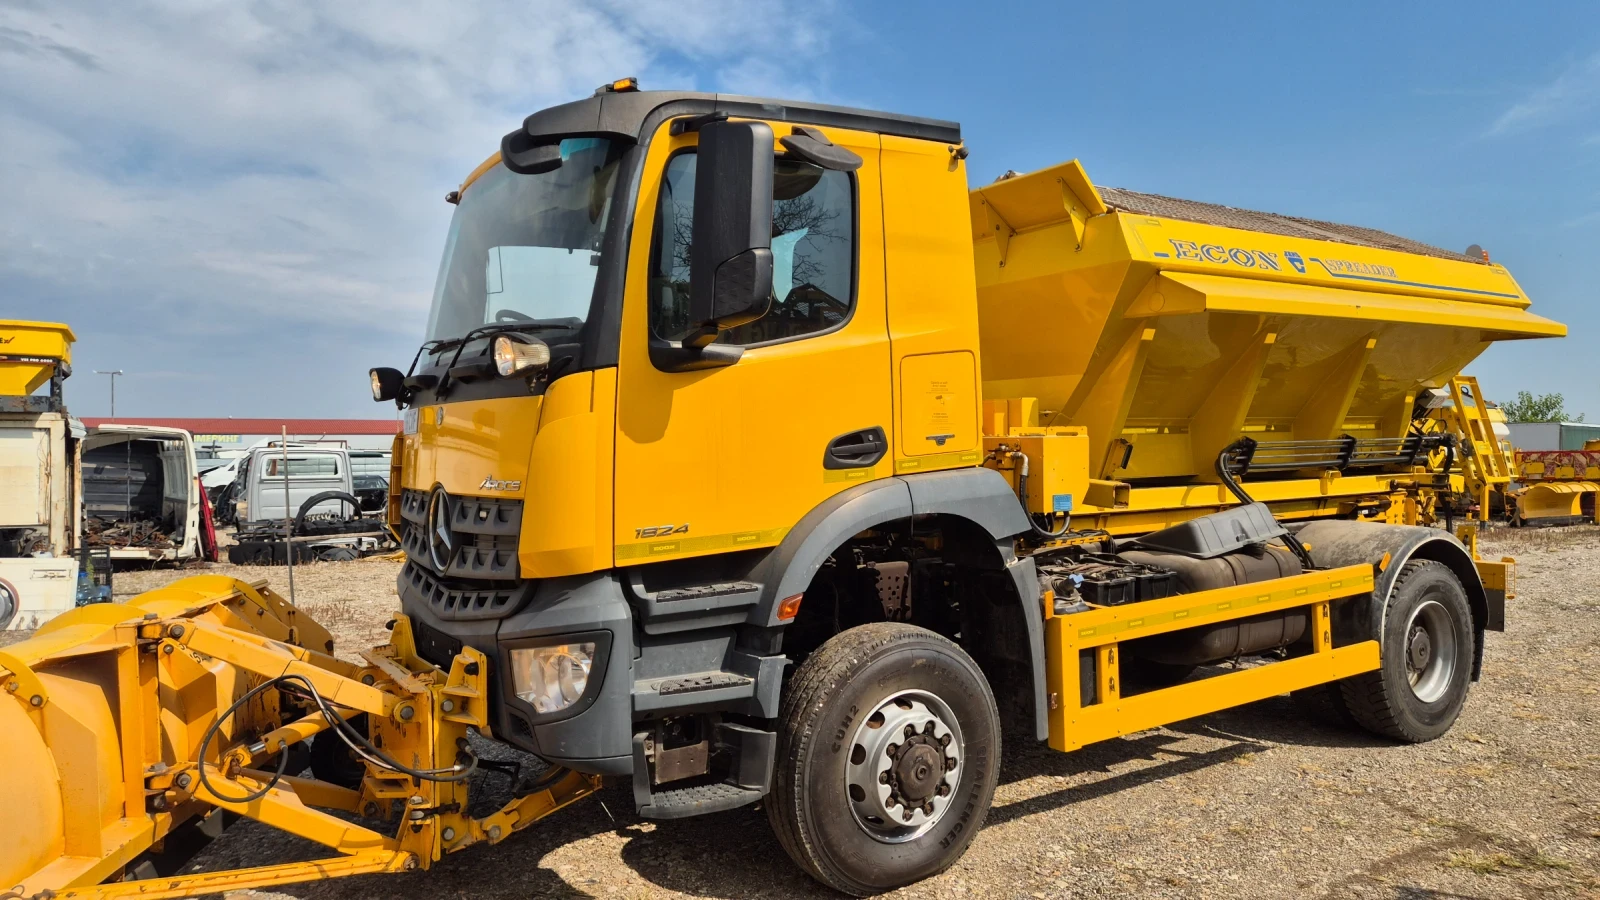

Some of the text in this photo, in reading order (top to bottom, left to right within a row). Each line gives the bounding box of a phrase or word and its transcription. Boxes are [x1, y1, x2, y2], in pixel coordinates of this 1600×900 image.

[1168, 239, 1283, 271] ECON
[1325, 258, 1398, 278] SPREADER
[635, 523, 690, 539] 1824
[939, 745, 987, 849] CHALLENGER
